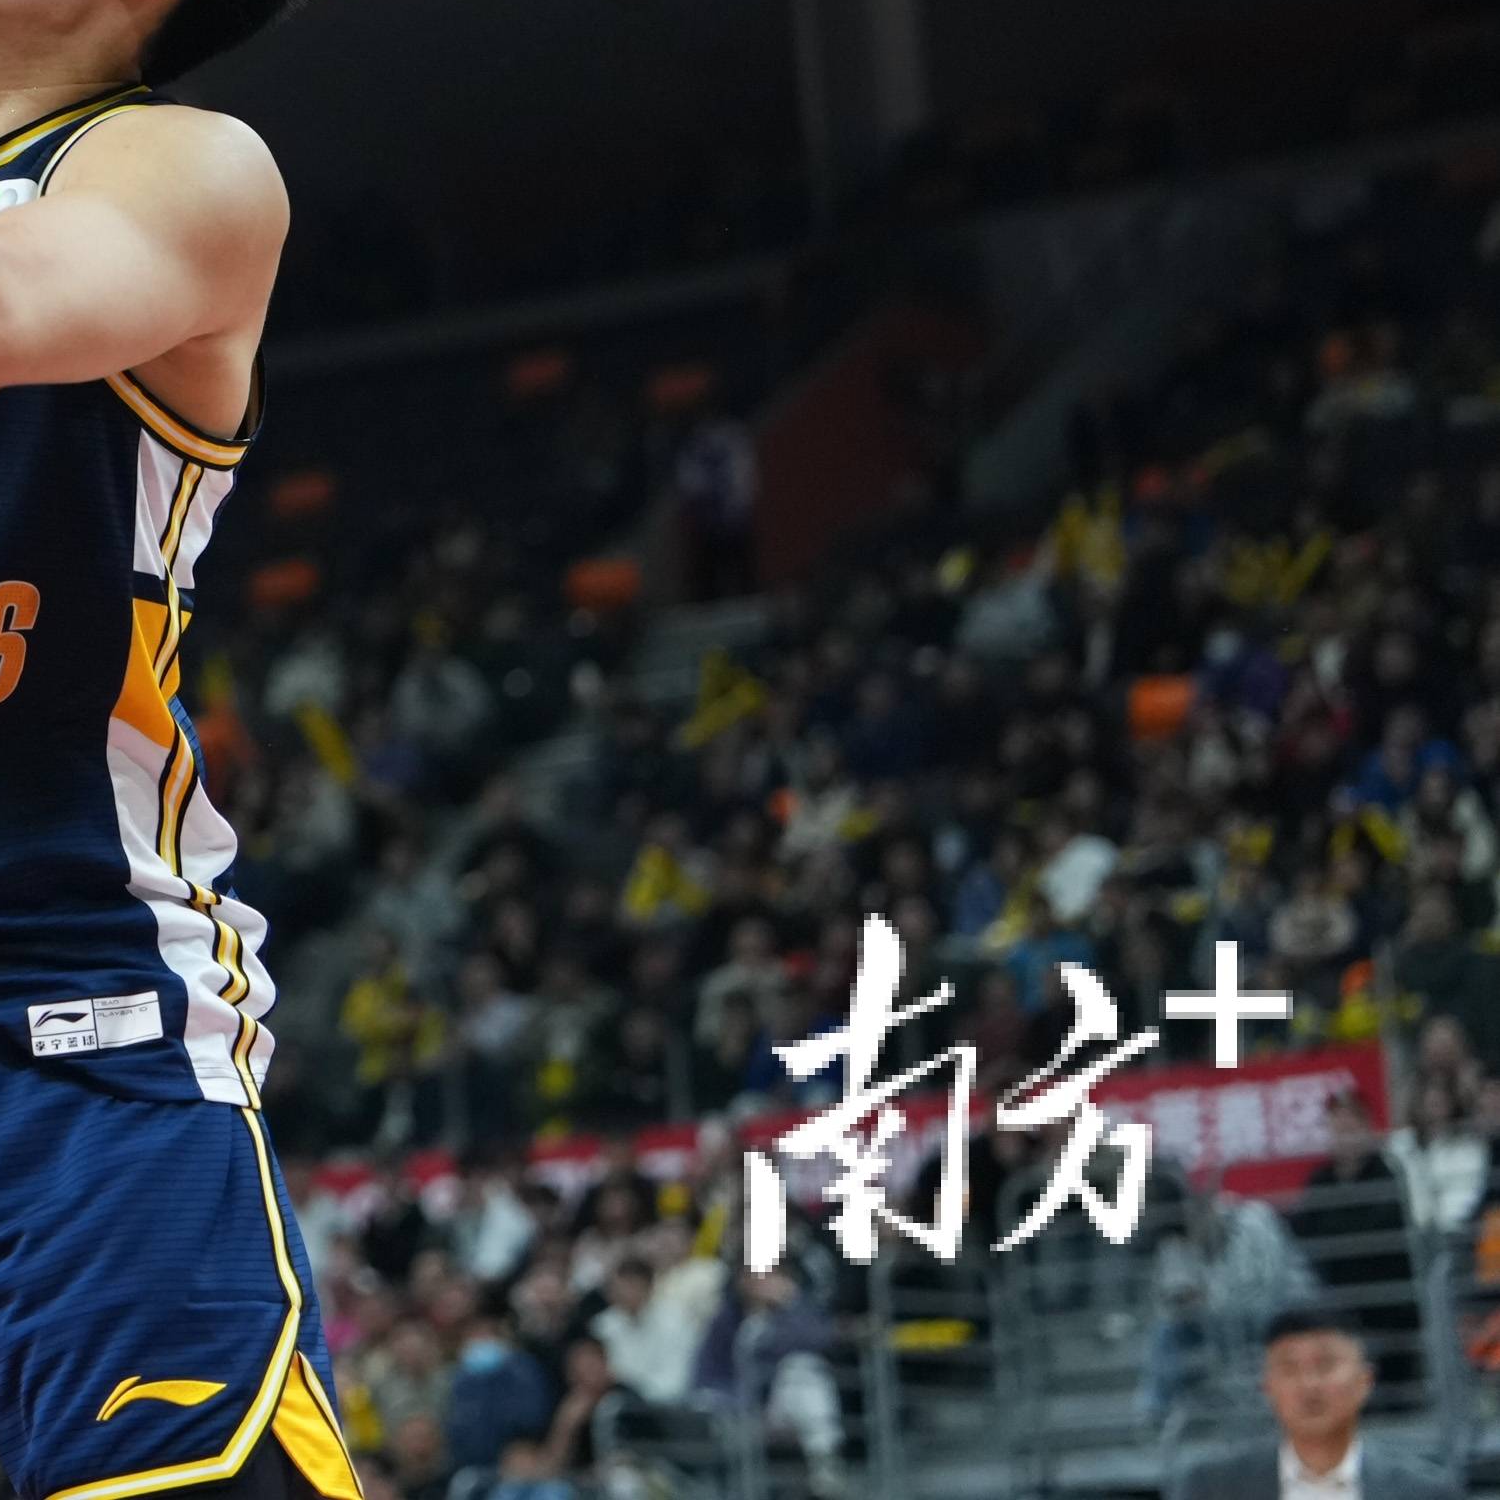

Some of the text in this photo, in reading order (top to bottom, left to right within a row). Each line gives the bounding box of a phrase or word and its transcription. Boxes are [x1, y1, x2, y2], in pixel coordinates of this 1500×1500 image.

[97, 1009, 133, 1018] PLAYER
[35, 1034, 96, 1052] 李宁篮球
